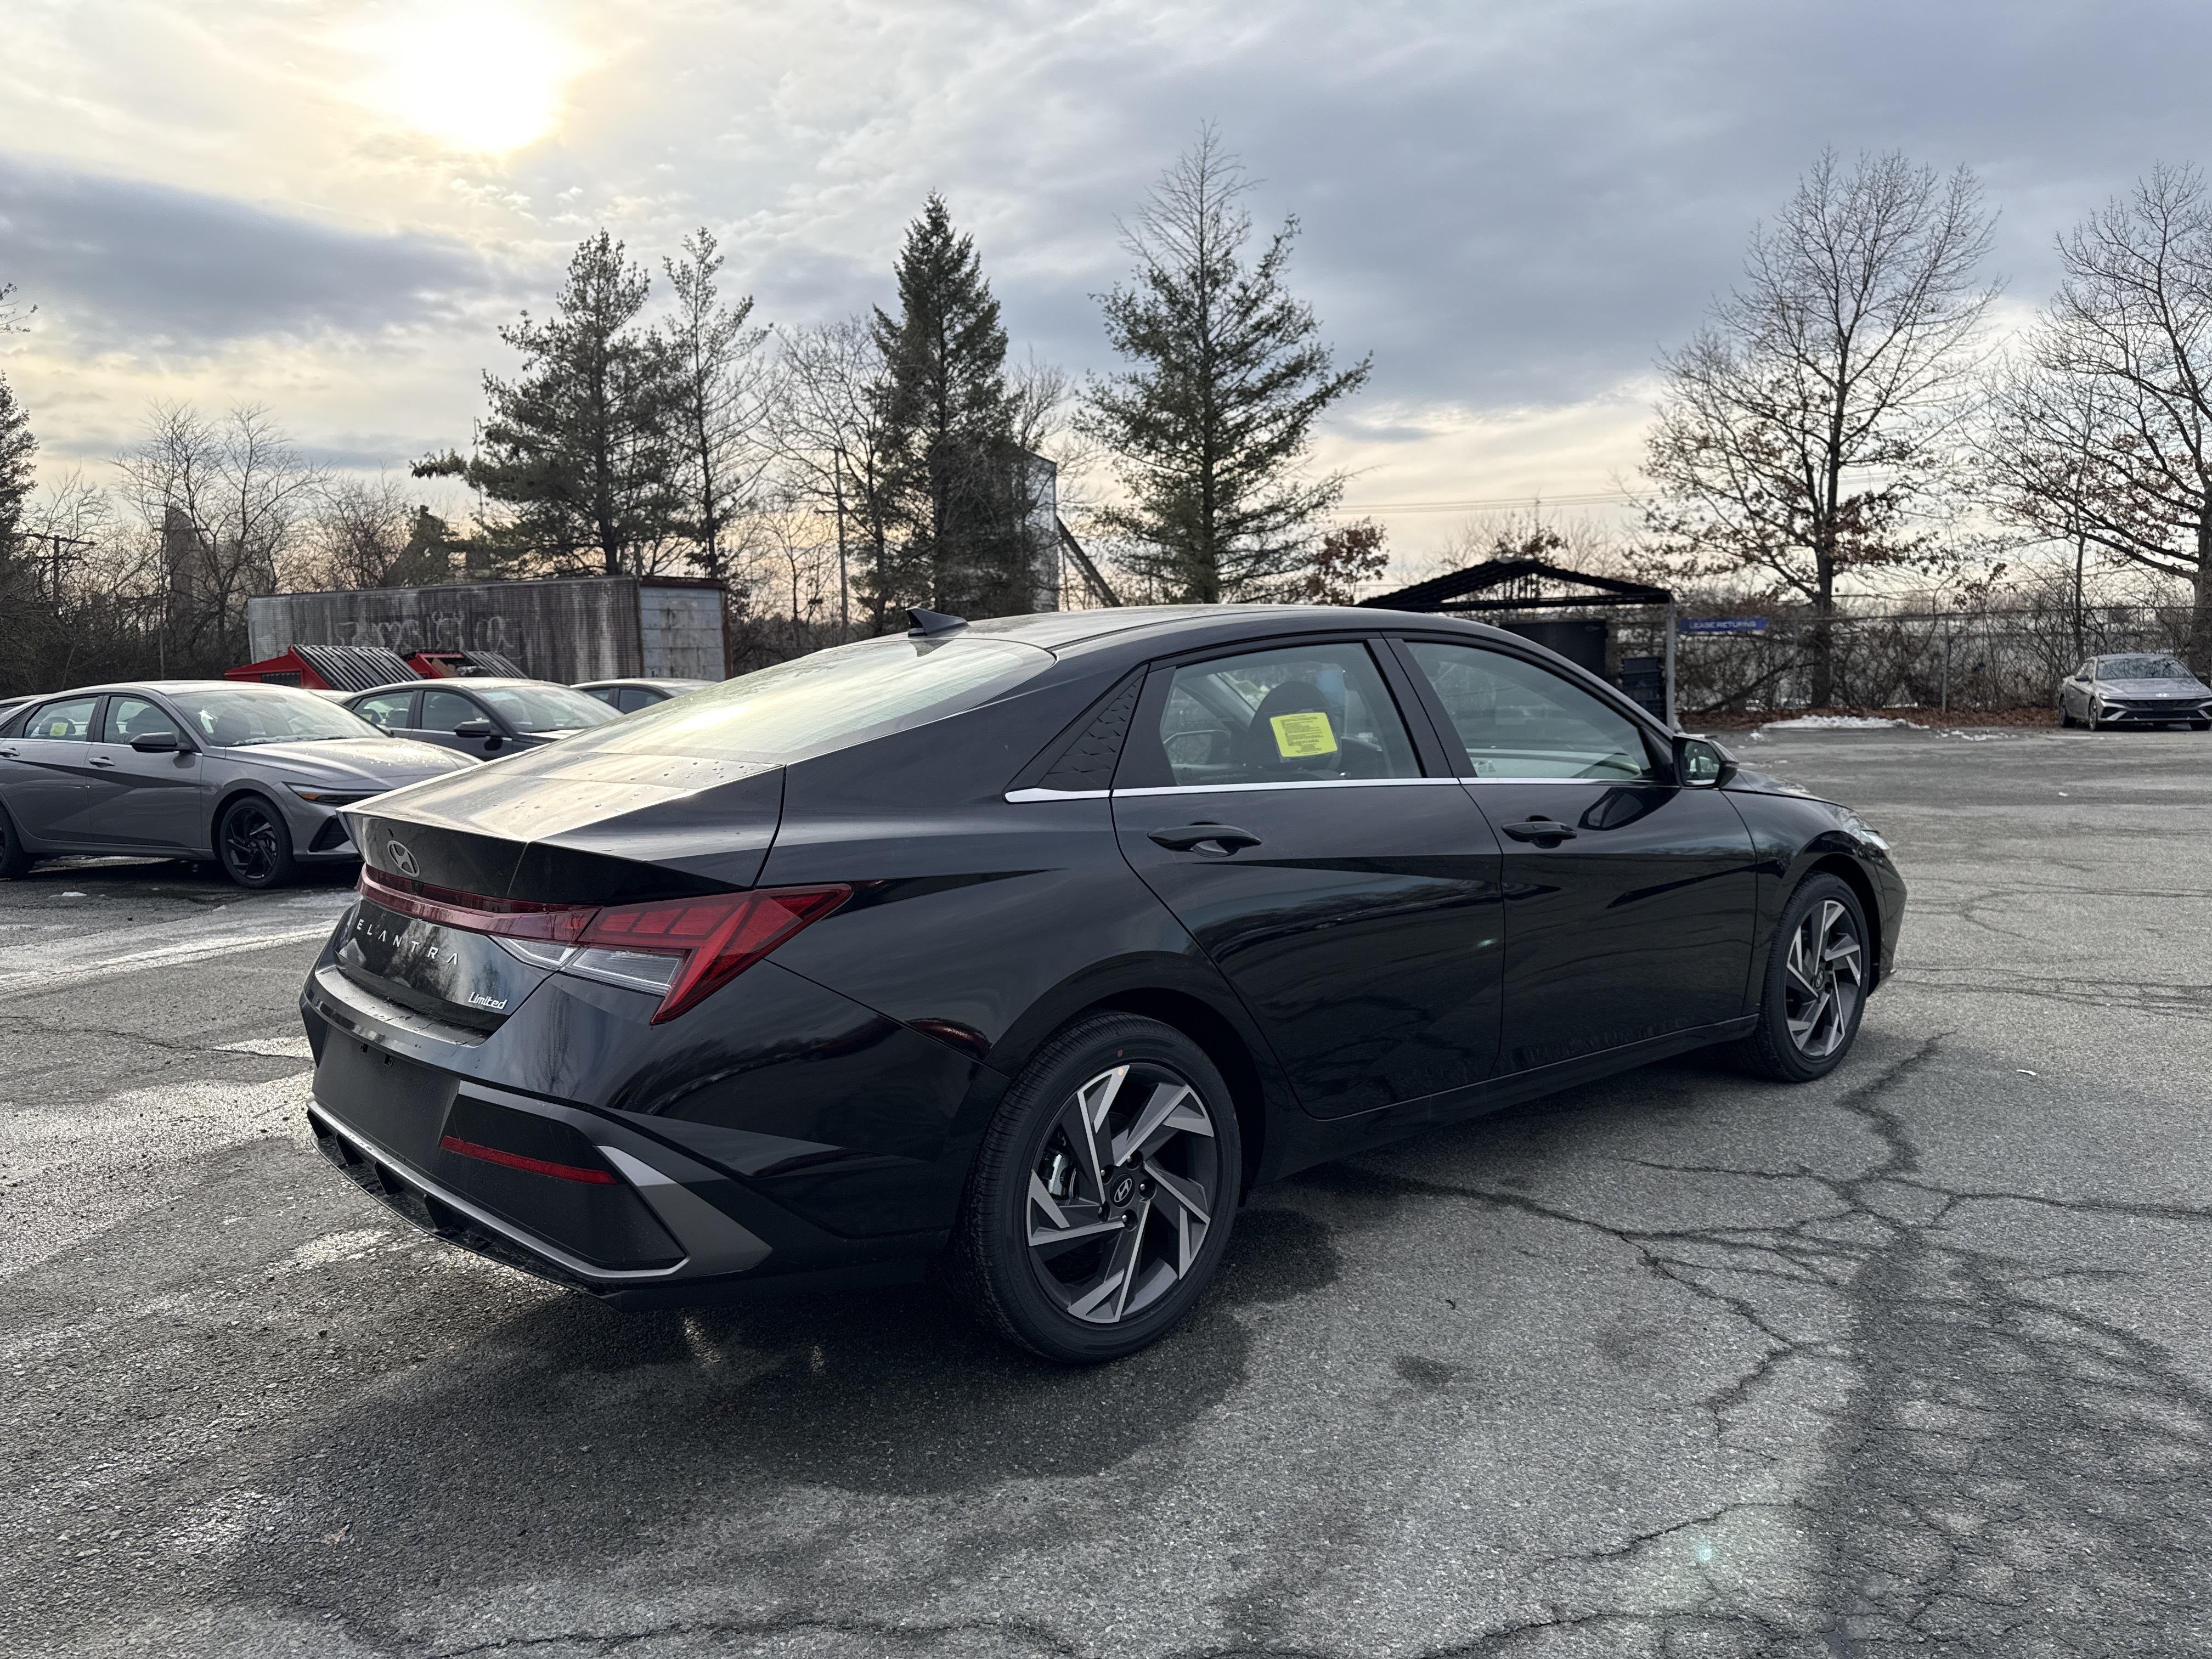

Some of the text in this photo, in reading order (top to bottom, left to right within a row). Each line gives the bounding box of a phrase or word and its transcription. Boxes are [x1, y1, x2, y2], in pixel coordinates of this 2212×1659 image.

[1689, 621, 1716, 629] LEASE
[356, 918, 459, 965] ELANTRA
[468, 991, 508, 1010] Limited
